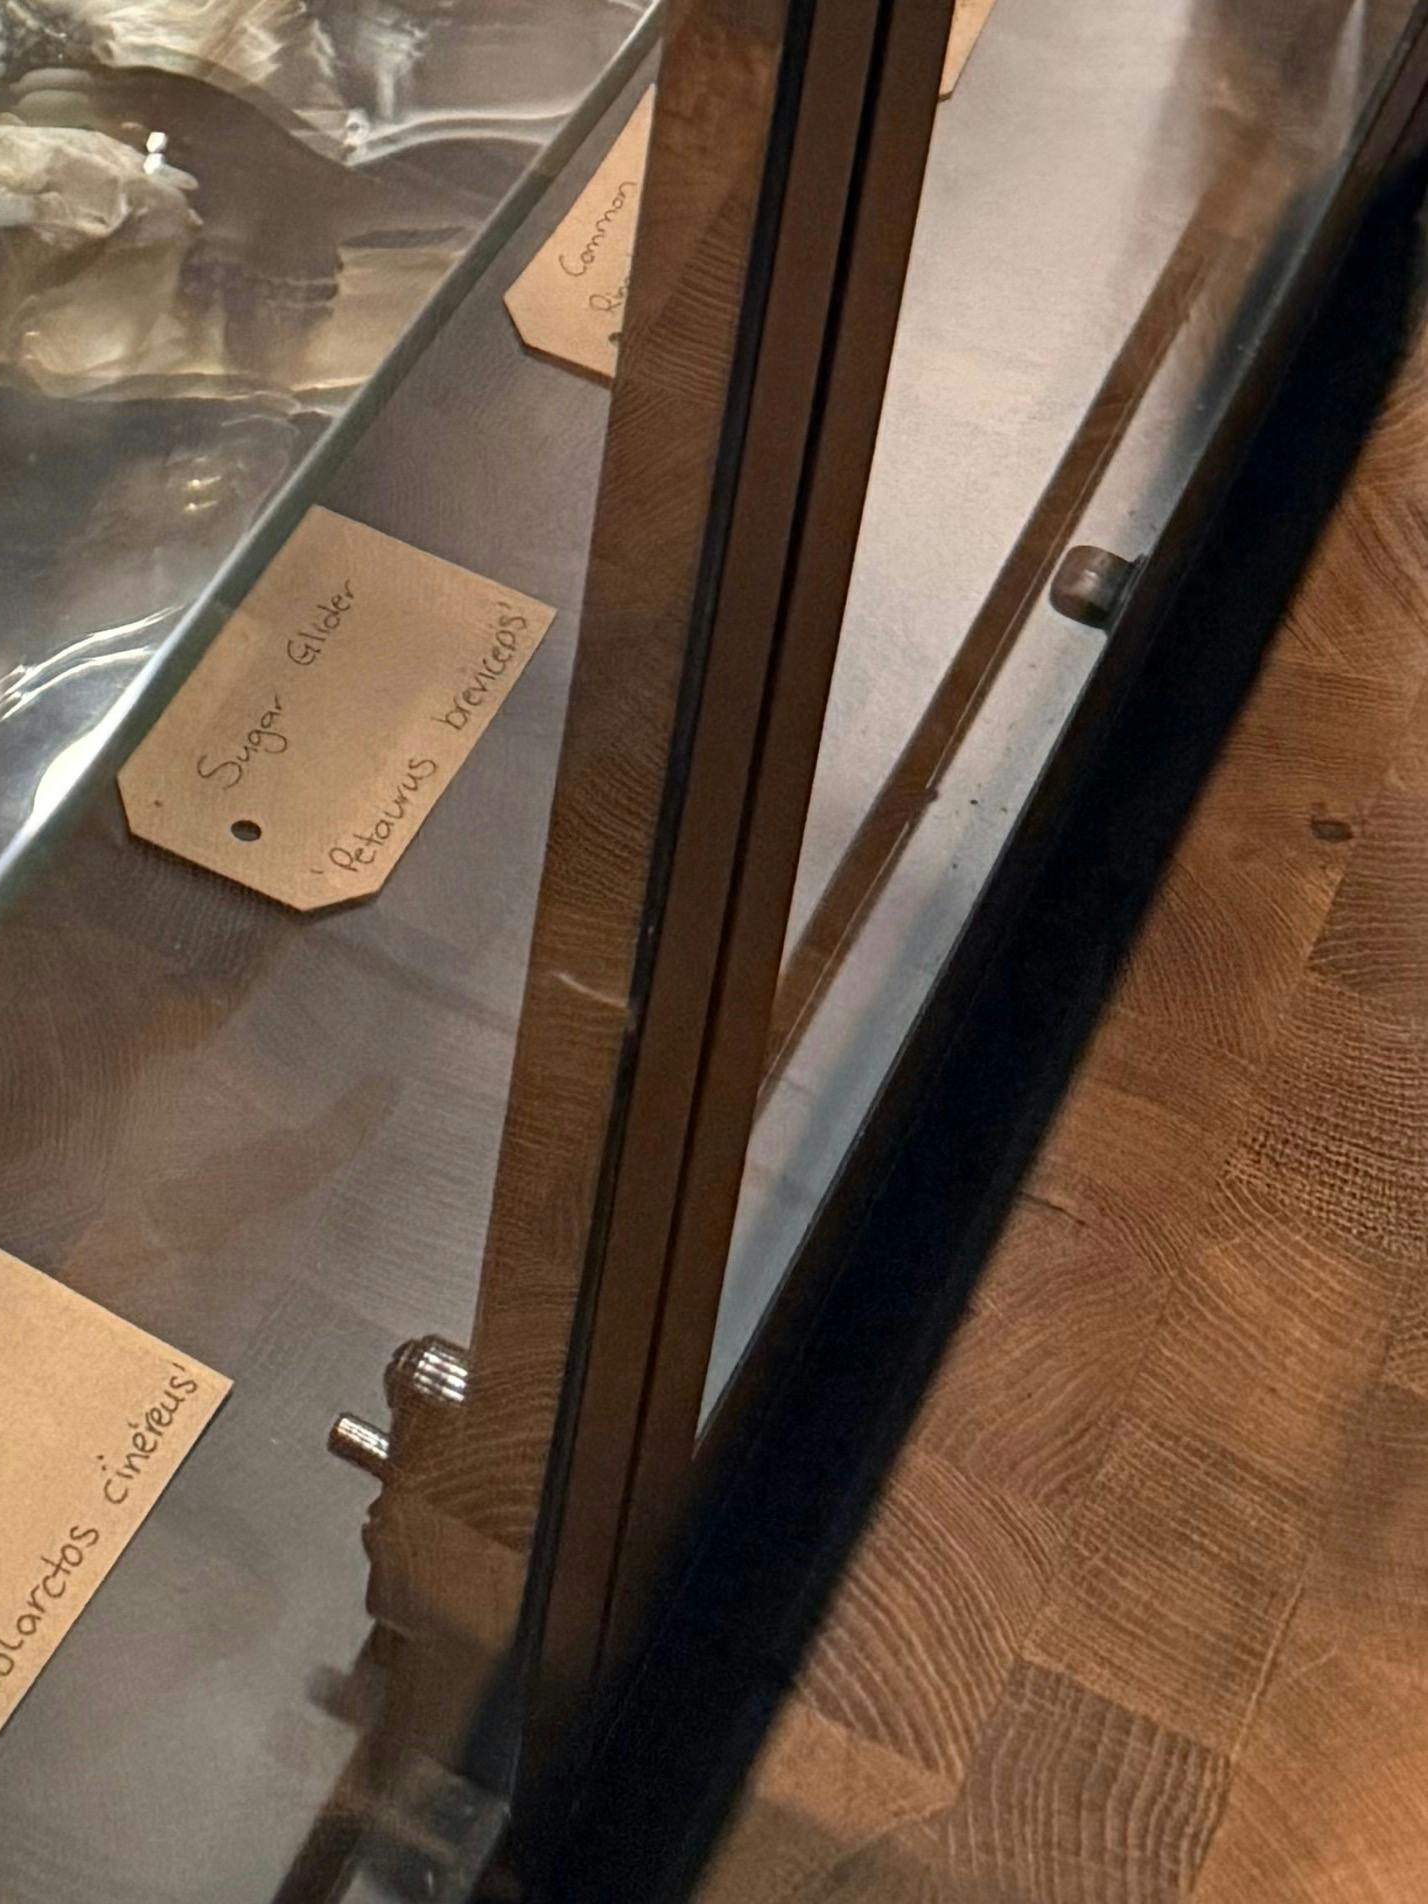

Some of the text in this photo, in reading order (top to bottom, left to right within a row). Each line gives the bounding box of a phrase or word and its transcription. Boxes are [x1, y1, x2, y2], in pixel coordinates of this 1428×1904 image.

[558, 181, 638, 277] Common
[198, 578, 356, 790] Sugar Glider
